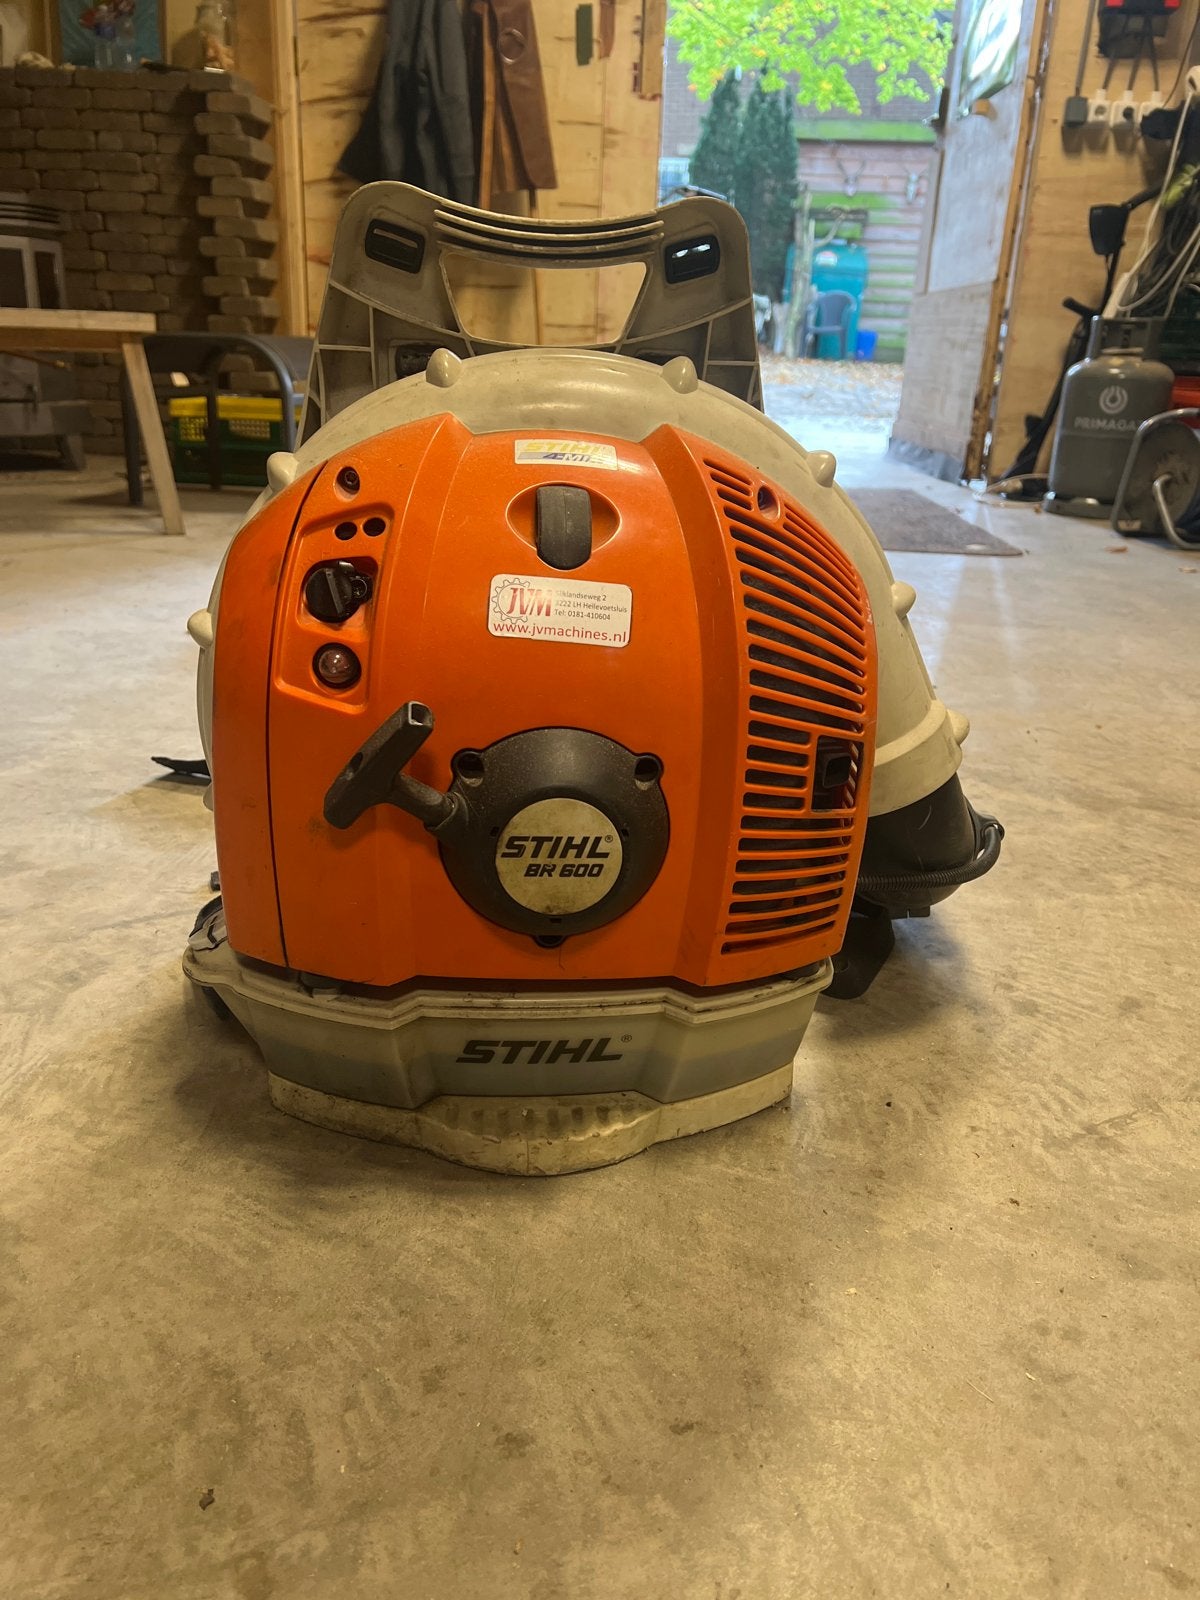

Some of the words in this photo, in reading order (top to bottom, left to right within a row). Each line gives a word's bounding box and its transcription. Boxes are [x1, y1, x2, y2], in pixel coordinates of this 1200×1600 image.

[1073, 415, 1138, 431] PRIMAGA
[506, 587, 553, 617] JVM
[567, 610, 611, 620] 0181-410604
[493, 622, 626, 643] www.jvmachines.nl
[524, 863, 556, 878] BR
[559, 863, 605, 878] 600
